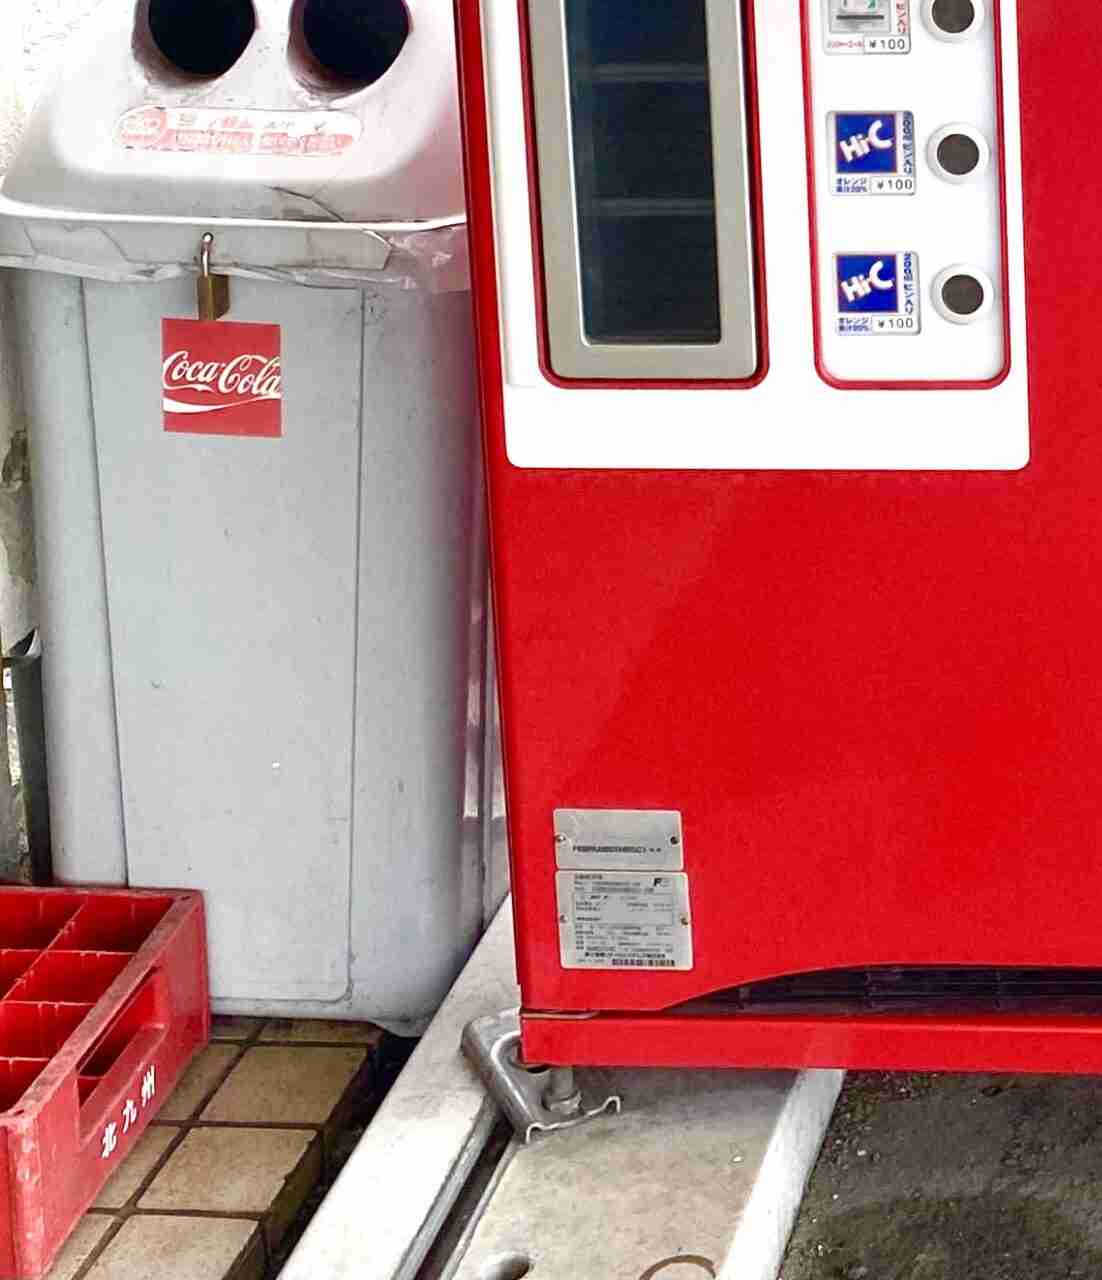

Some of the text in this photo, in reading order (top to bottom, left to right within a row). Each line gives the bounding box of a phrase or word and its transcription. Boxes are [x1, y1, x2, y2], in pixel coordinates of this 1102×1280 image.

[868, 38, 906, 51] ¥100
[877, 179, 913, 191] ¥100
[878, 318, 914, 330] ¥100
[162, 350, 281, 395] Coca-Cola
